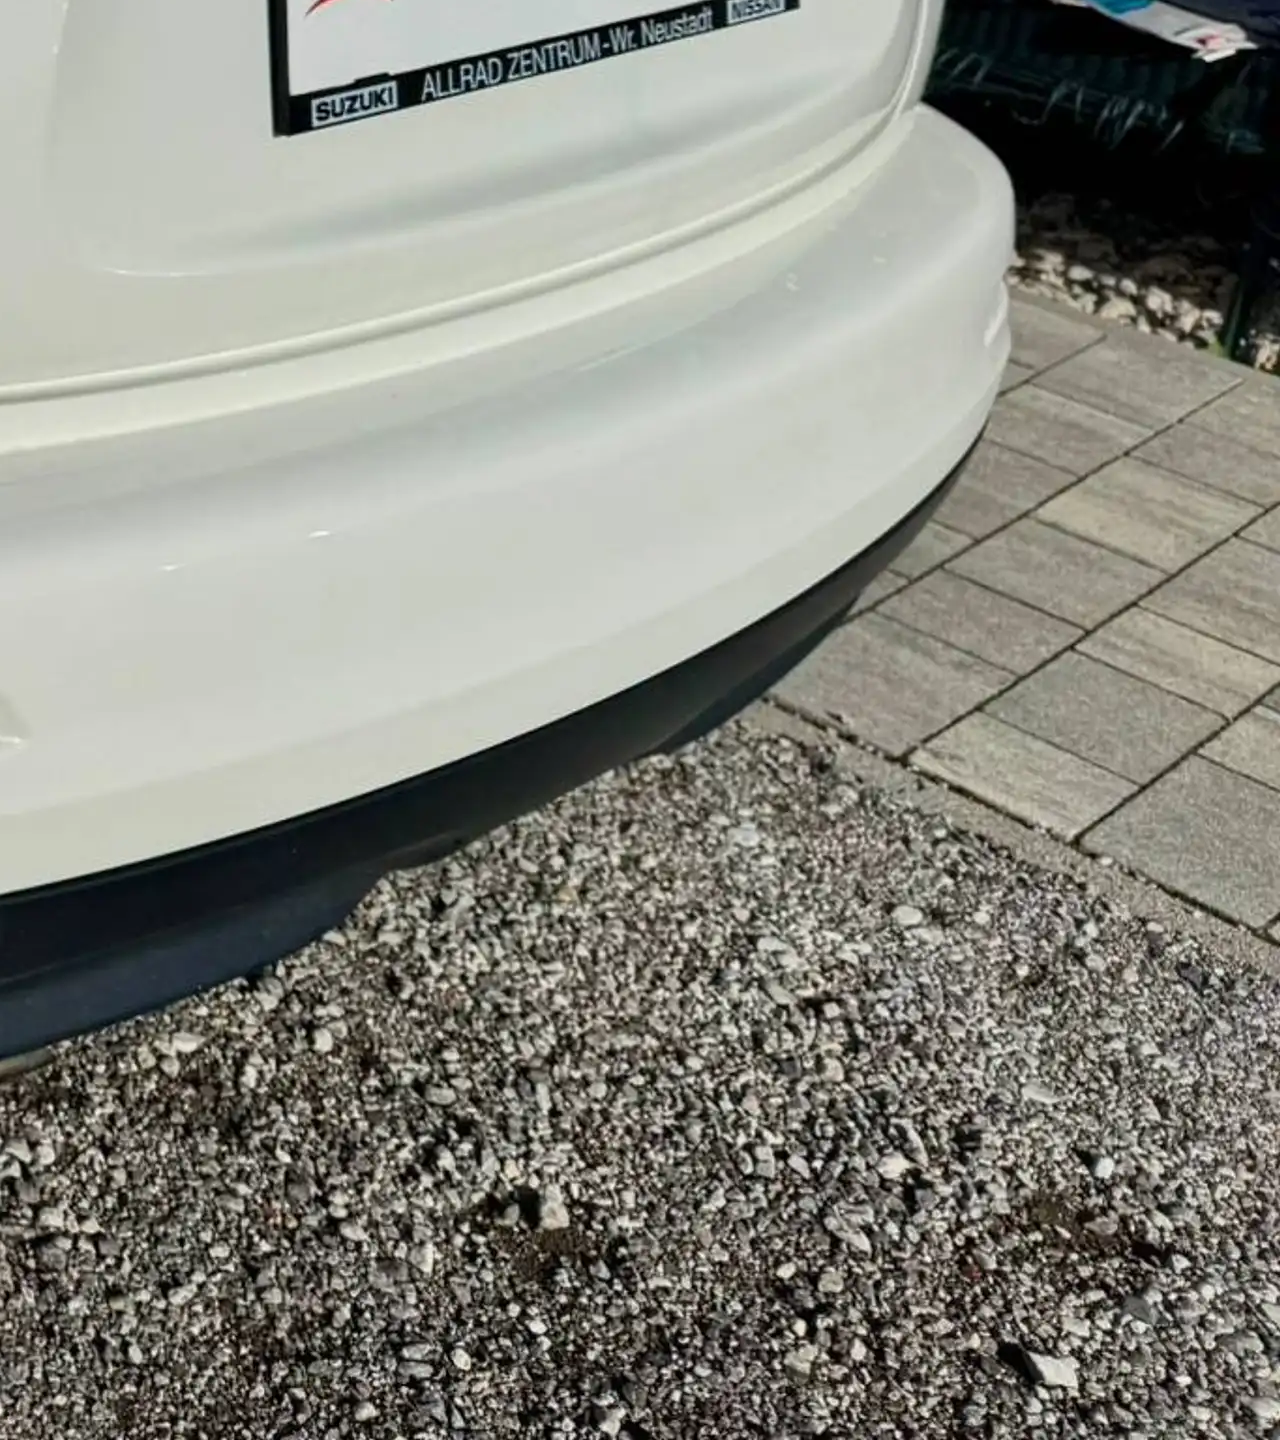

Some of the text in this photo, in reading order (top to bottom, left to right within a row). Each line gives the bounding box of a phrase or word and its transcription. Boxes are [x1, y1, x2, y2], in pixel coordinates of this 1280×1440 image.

[421, 57, 503, 101] ALLRAD
[641, 7, 713, 47] Neustadt
[315, 85, 395, 122] SUZUKI
